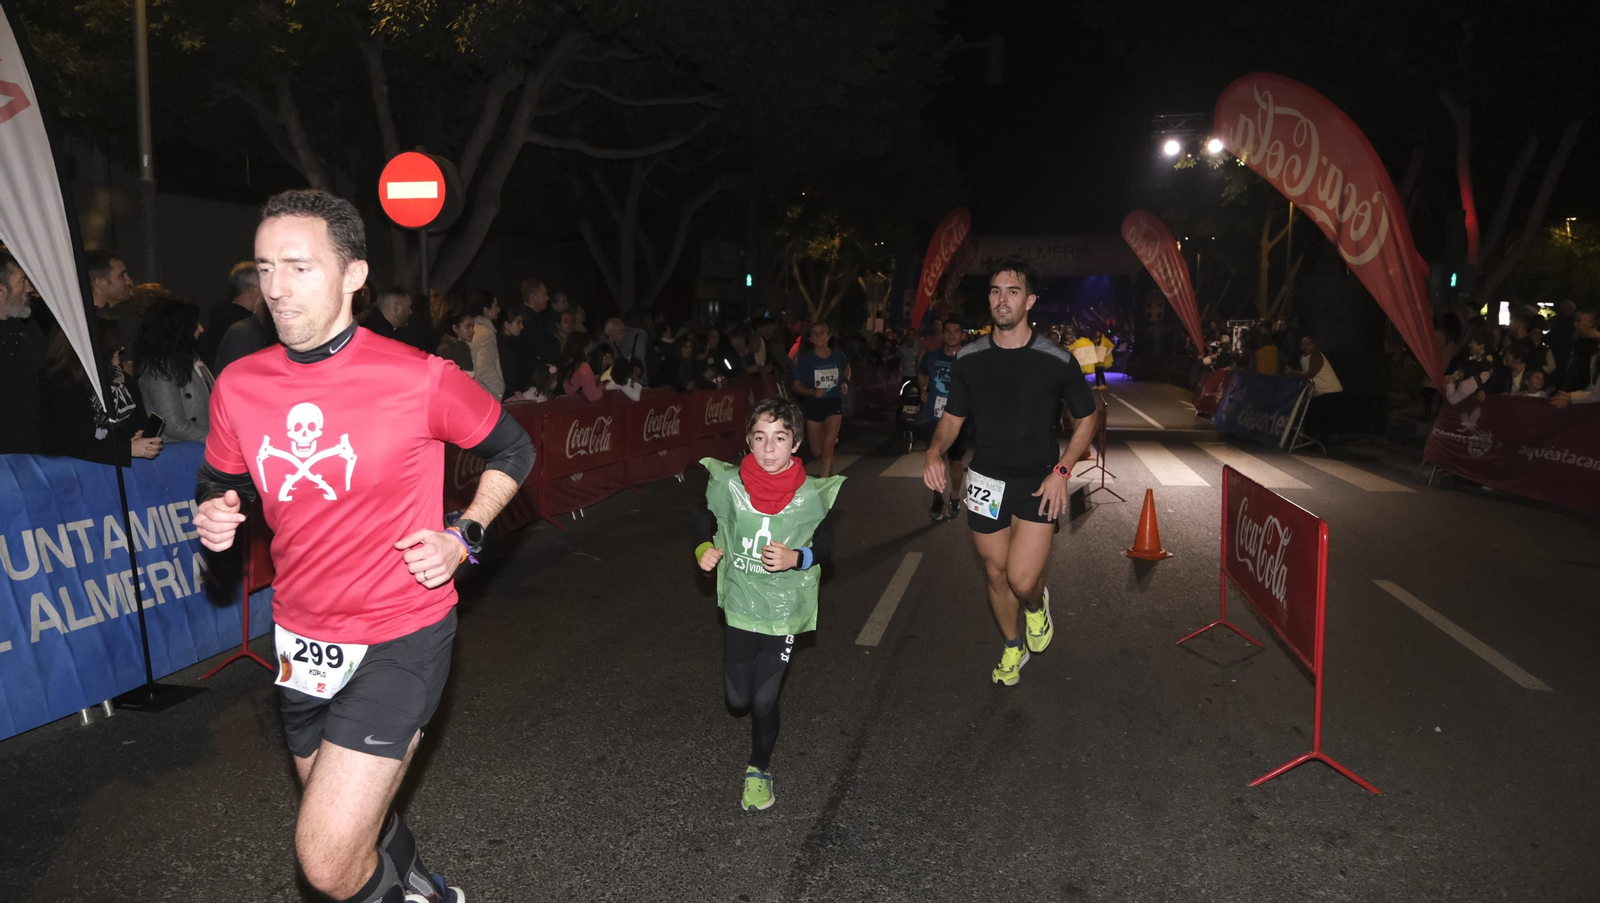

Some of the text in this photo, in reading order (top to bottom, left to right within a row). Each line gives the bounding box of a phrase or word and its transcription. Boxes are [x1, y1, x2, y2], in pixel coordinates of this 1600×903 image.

[923, 213, 967, 297] Coca-Cola
[643, 404, 682, 442] Coca-Cola
[705, 394, 735, 426] Coca-Cola
[566, 415, 614, 459] Coca-Cola
[967, 484, 991, 502] 472
[1235, 496, 1293, 604] Coca-Cola
[293, 638, 344, 669] 299
